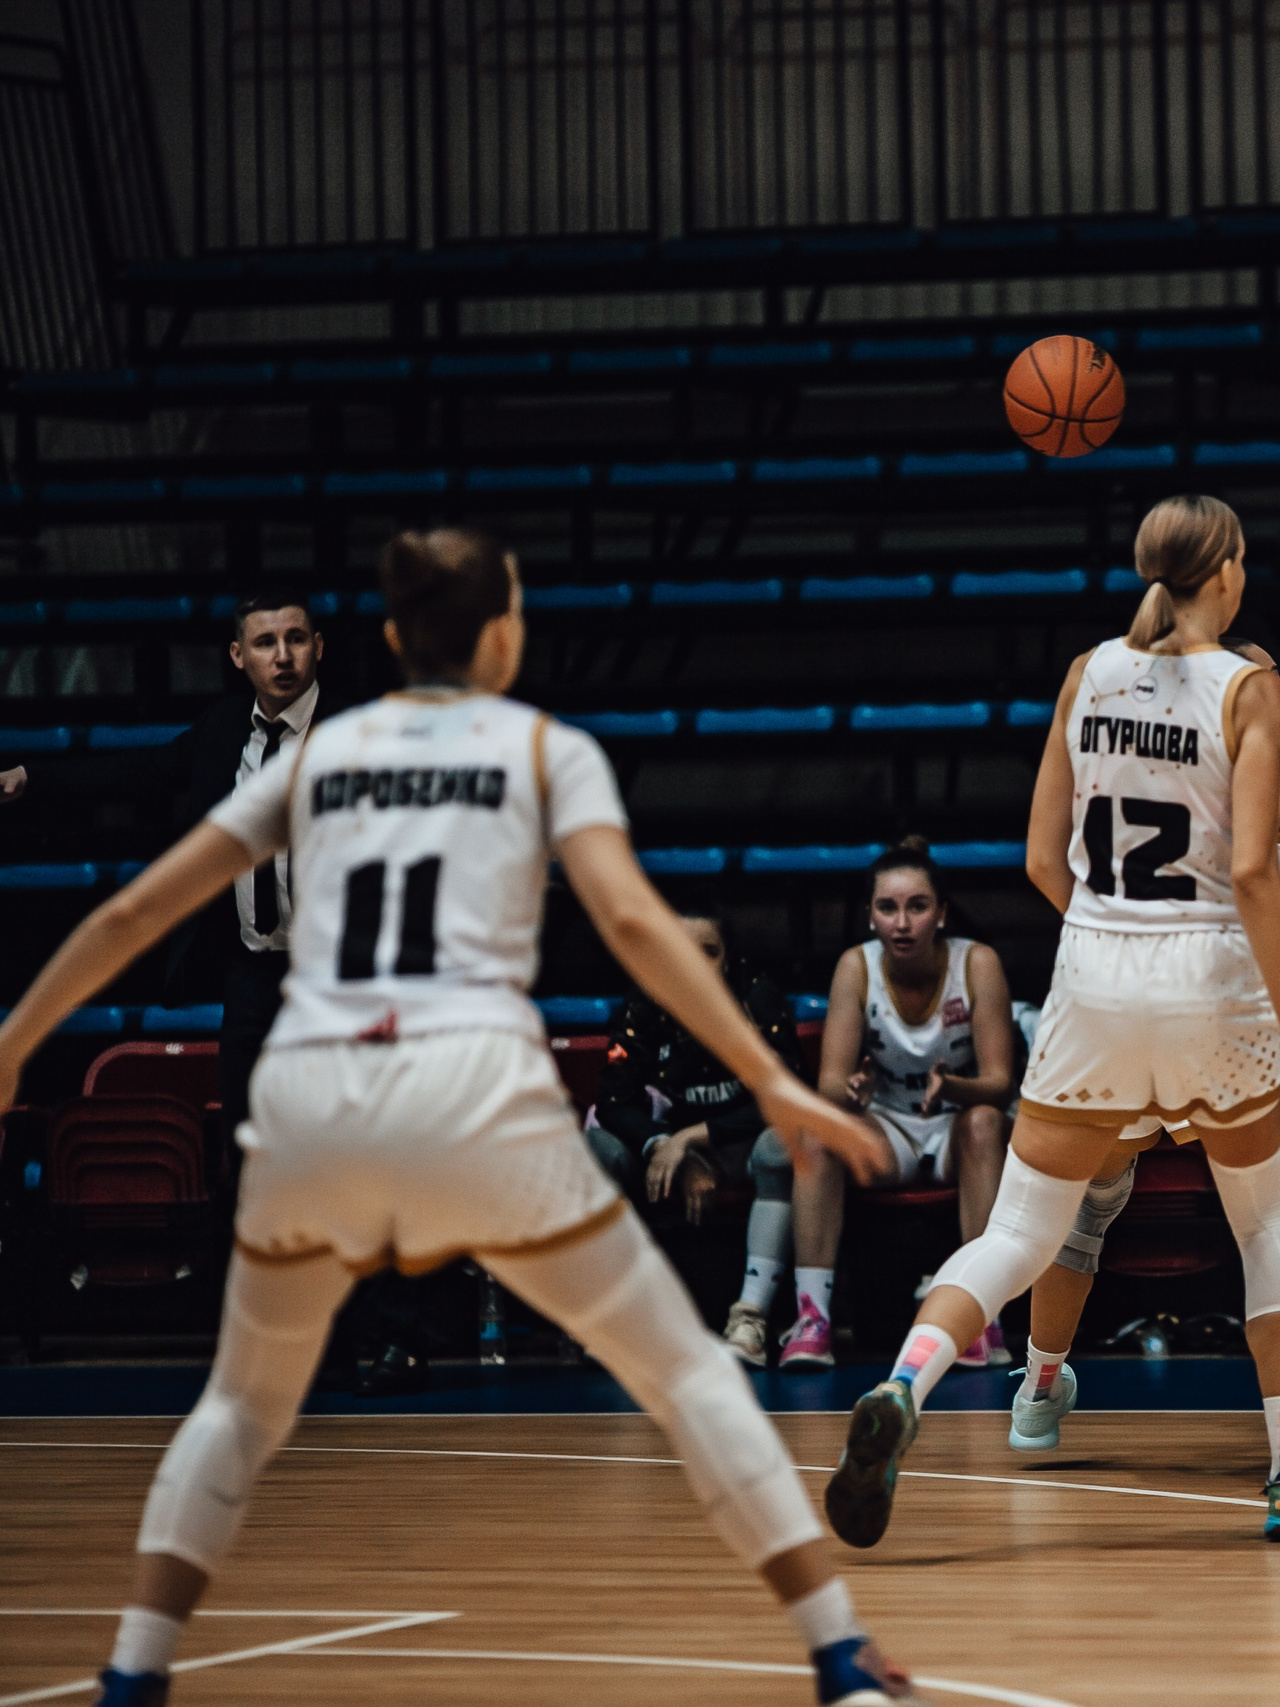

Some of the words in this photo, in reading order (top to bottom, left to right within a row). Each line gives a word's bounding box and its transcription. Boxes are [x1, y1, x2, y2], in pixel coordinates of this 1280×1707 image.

[1080, 716, 1198, 766] ОГУРЦОВА
[1083, 796, 1197, 901] 12
[339, 856, 441, 979] 11
